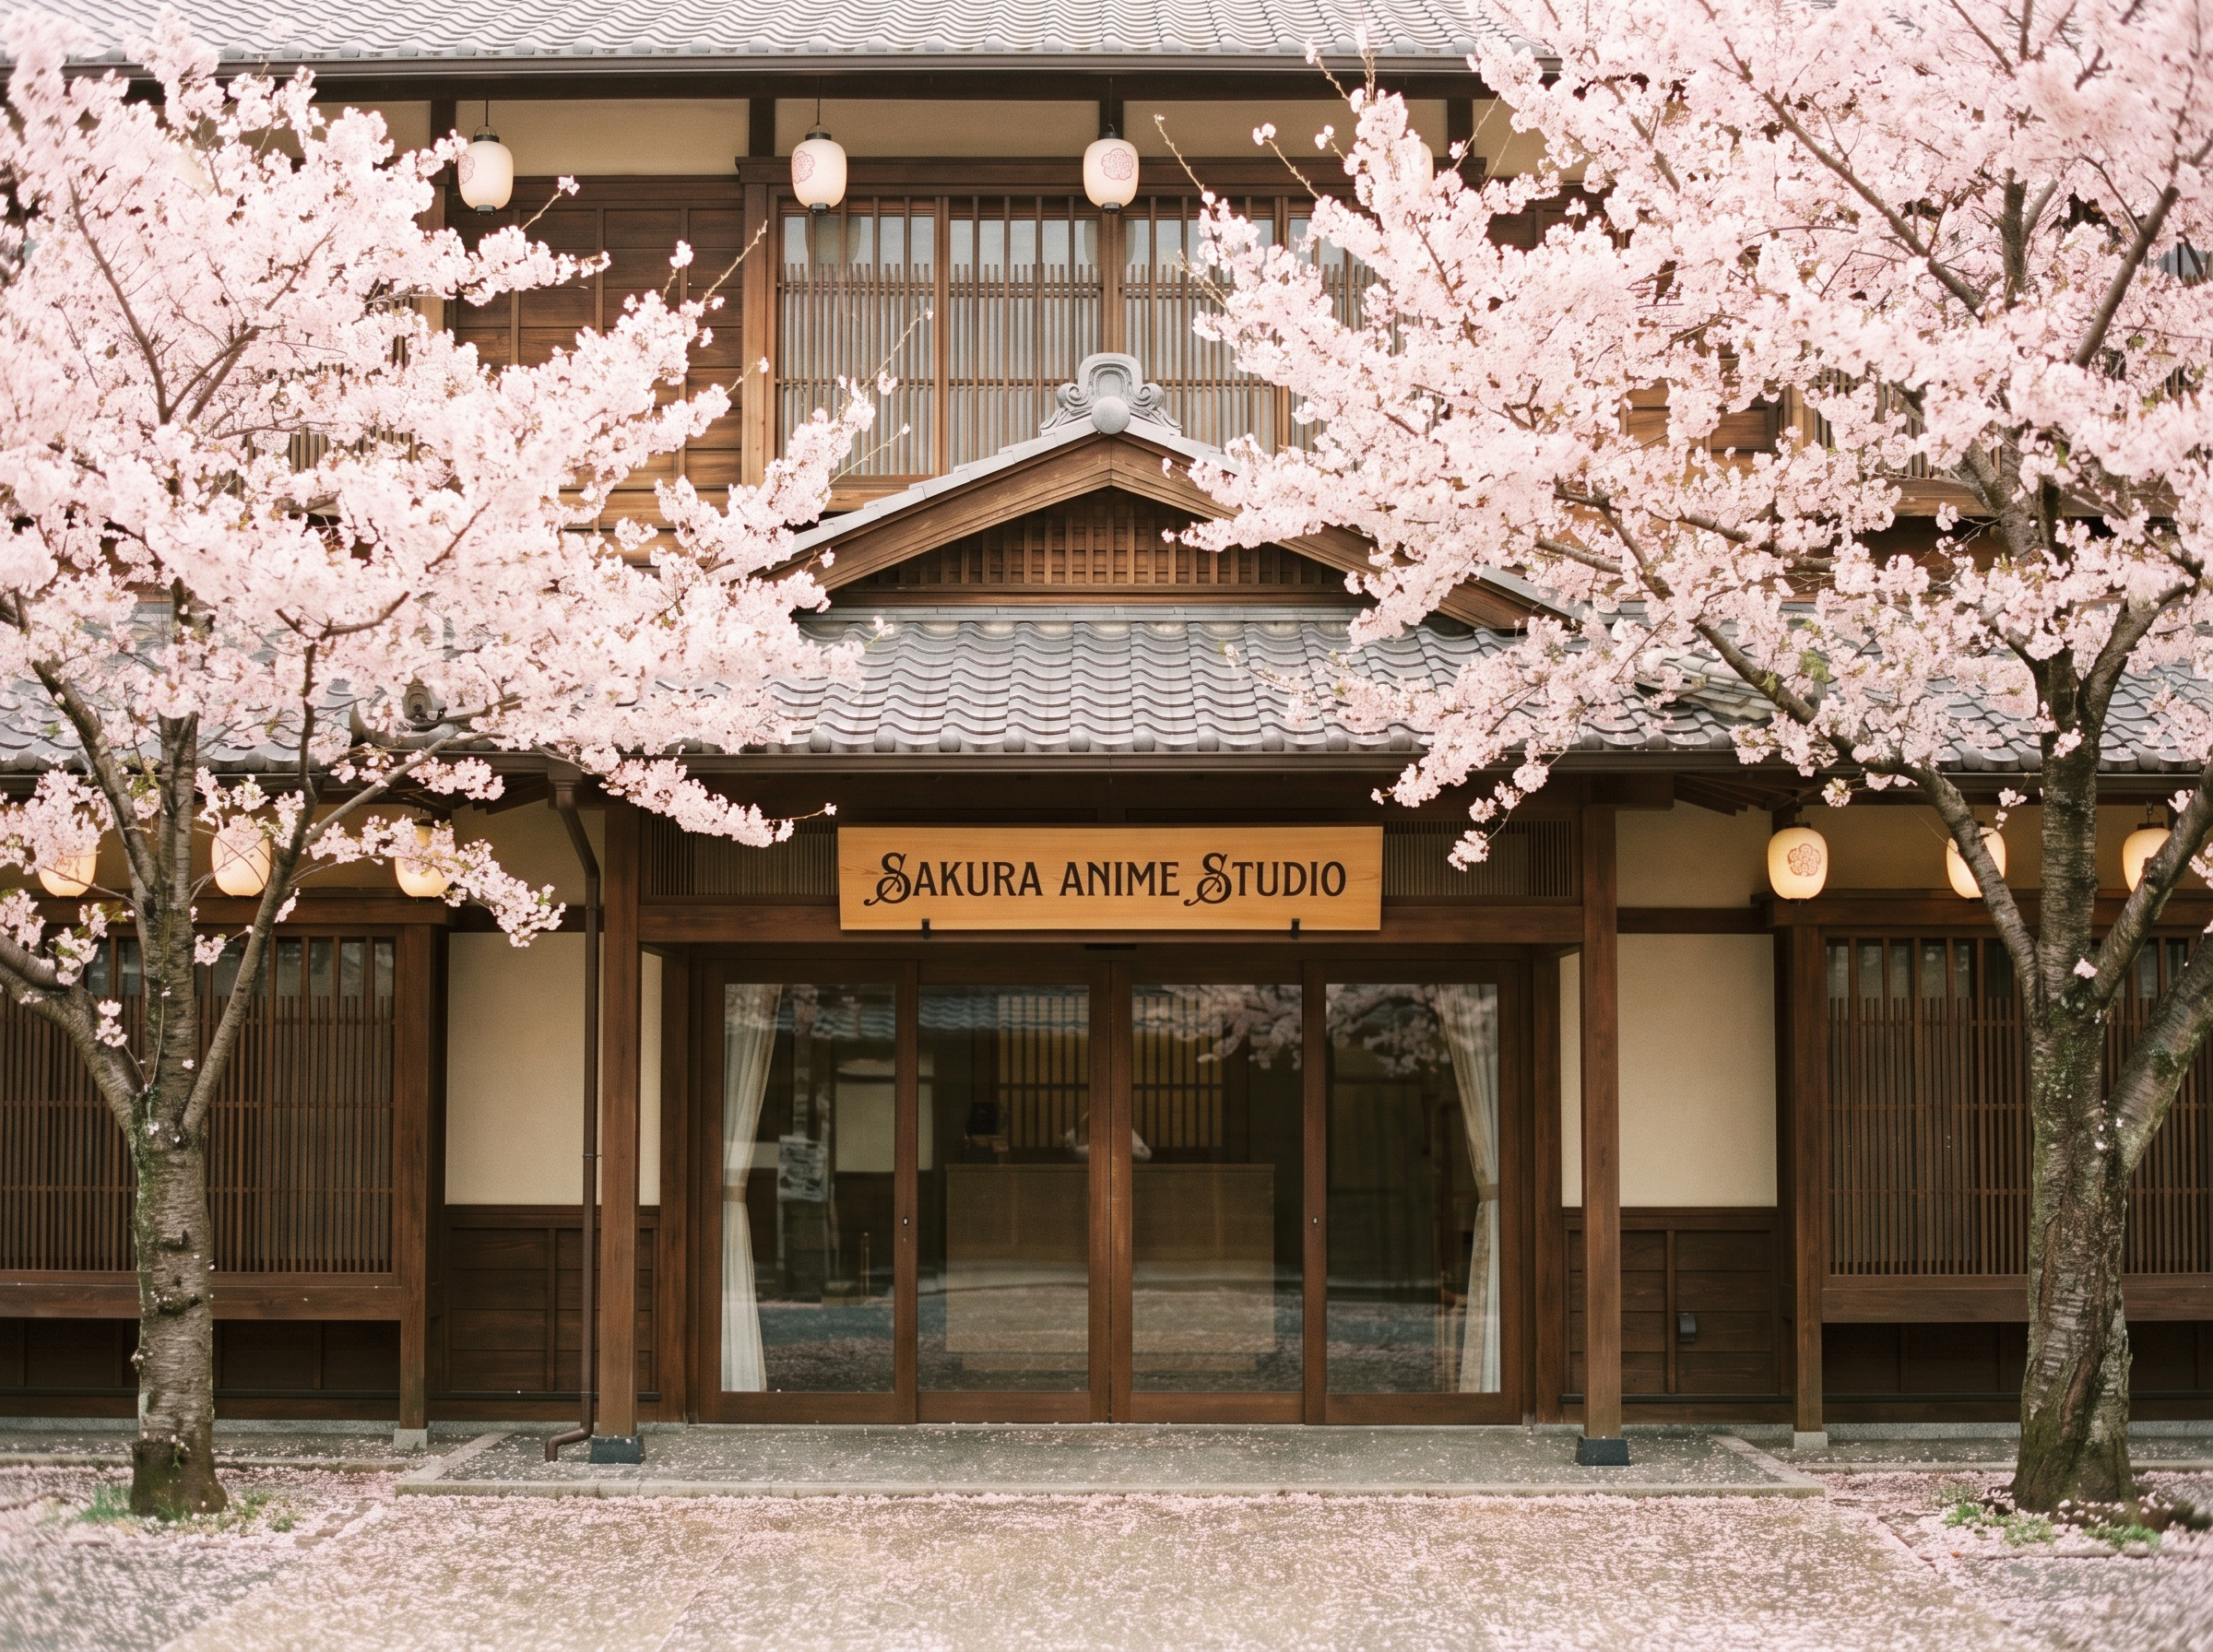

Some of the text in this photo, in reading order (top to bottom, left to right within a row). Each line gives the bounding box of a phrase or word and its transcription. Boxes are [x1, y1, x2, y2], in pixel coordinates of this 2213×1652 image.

[863, 852, 1346, 907] SAKURA ANIME STUDIO
